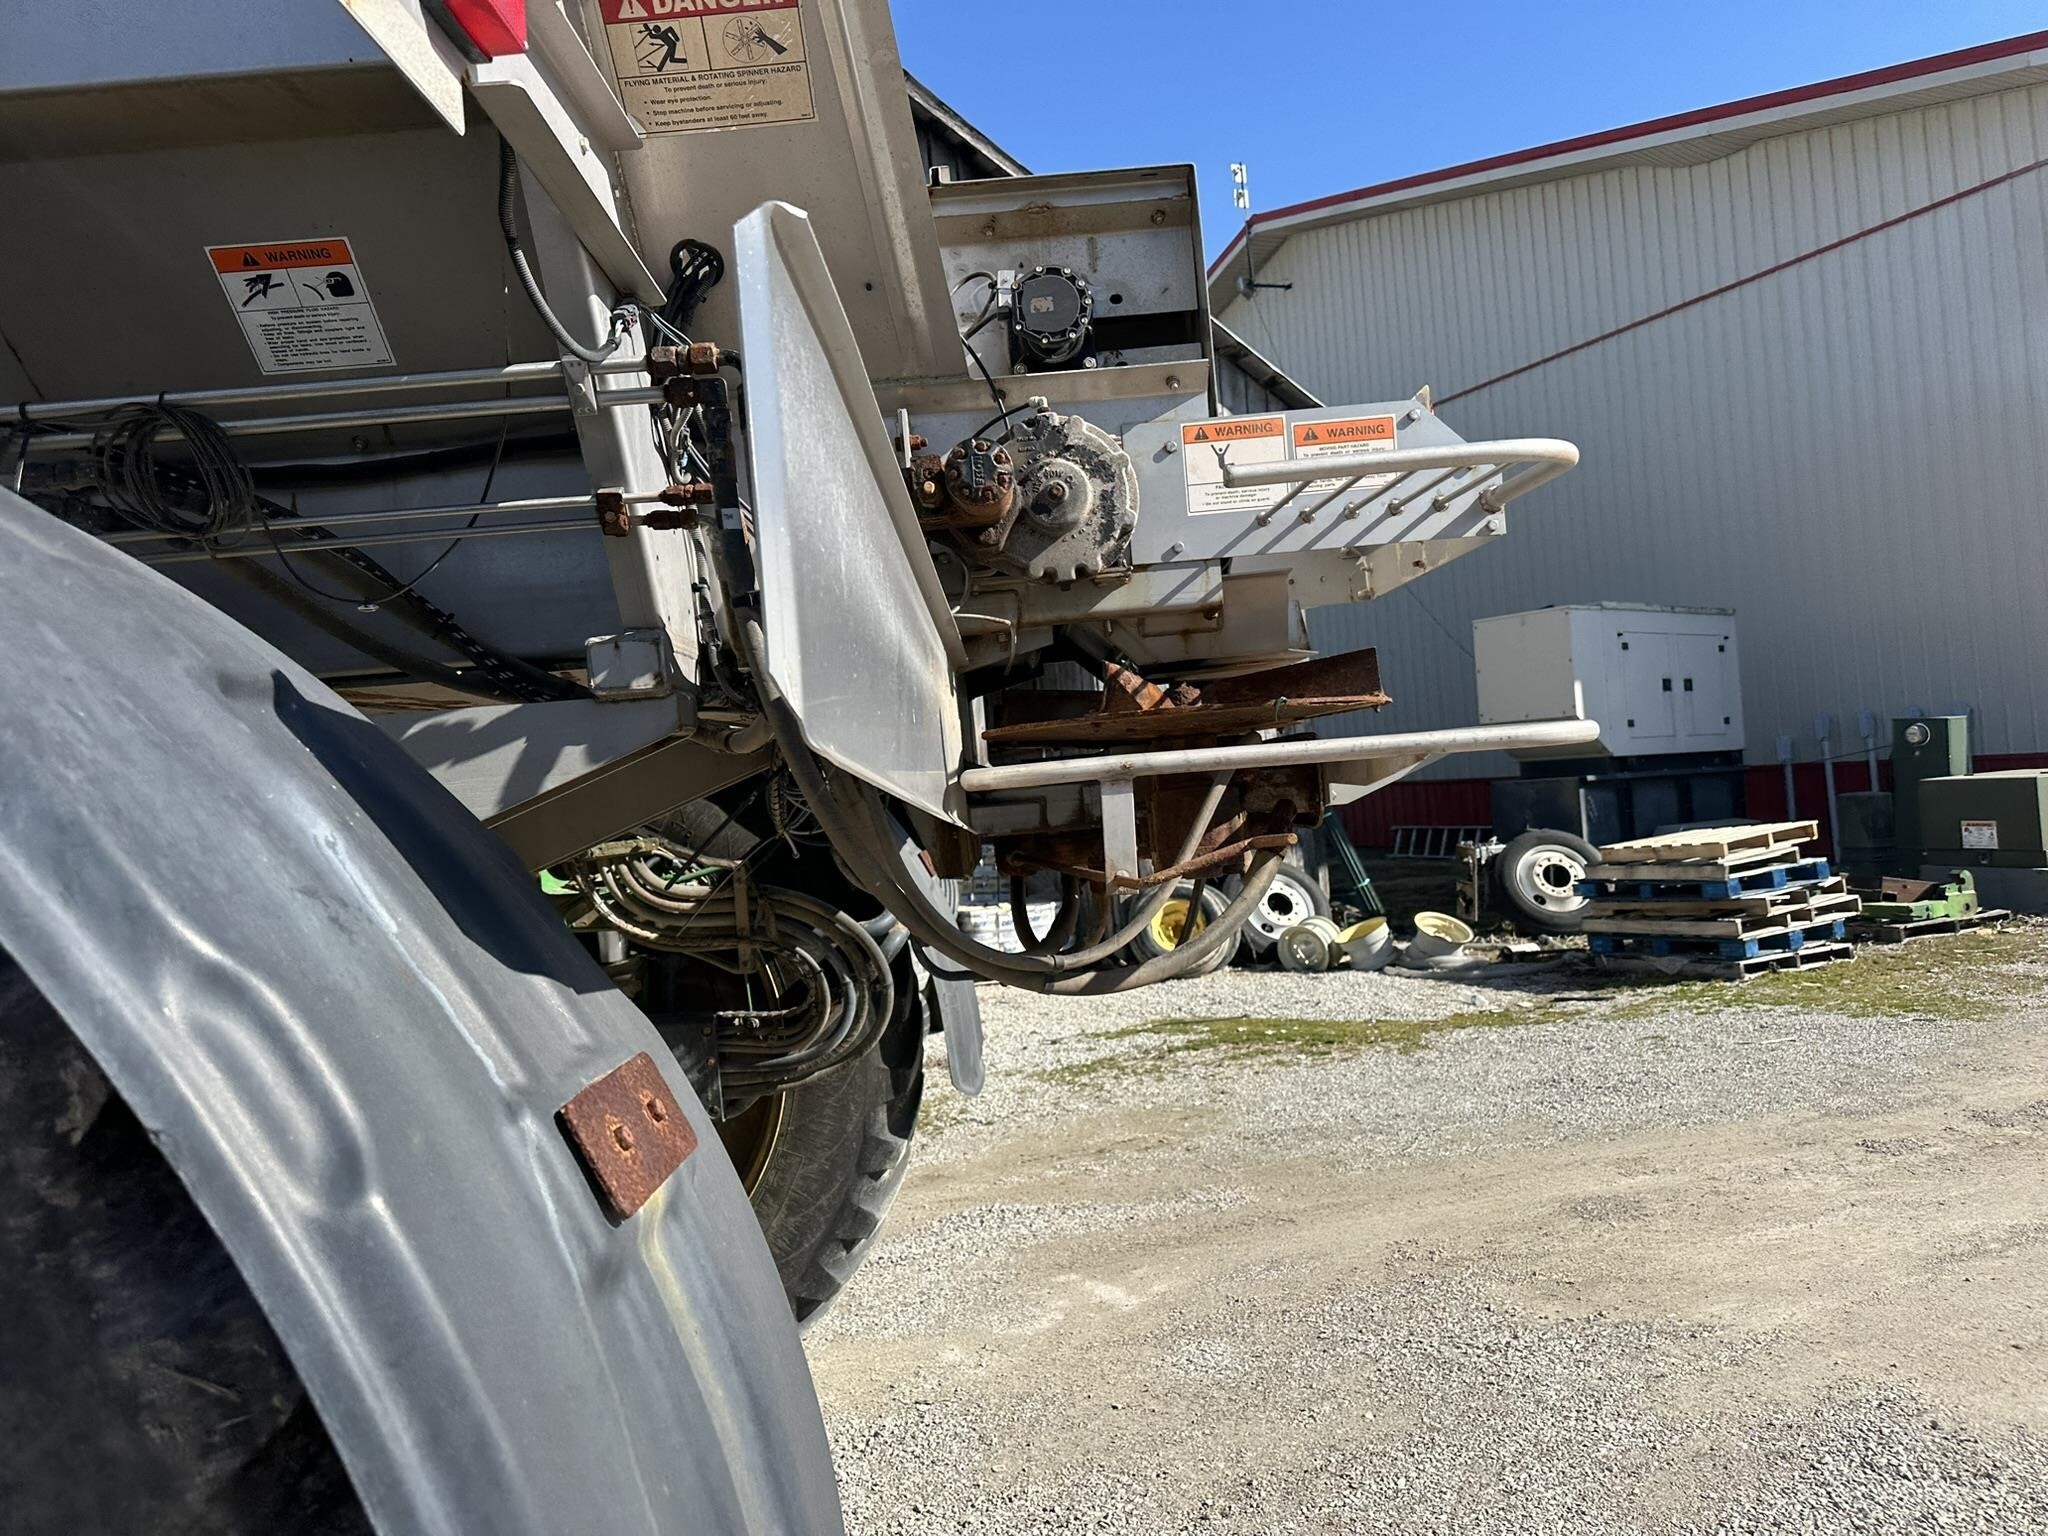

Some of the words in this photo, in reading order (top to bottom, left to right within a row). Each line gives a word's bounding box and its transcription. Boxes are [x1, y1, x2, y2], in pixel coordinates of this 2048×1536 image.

[624, 79, 650, 87] FLYING
[652, 76, 689, 85] MATERIAL
[699, 71, 735, 80] ROTATING
[736, 68, 769, 77] SPINNER
[771, 65, 801, 74] HAZARD
[673, 85, 696, 93] prevent
[264, 248, 331, 263] WARNING
[1214, 423, 1273, 436] WARNING
[1326, 424, 1385, 438] WARNING
